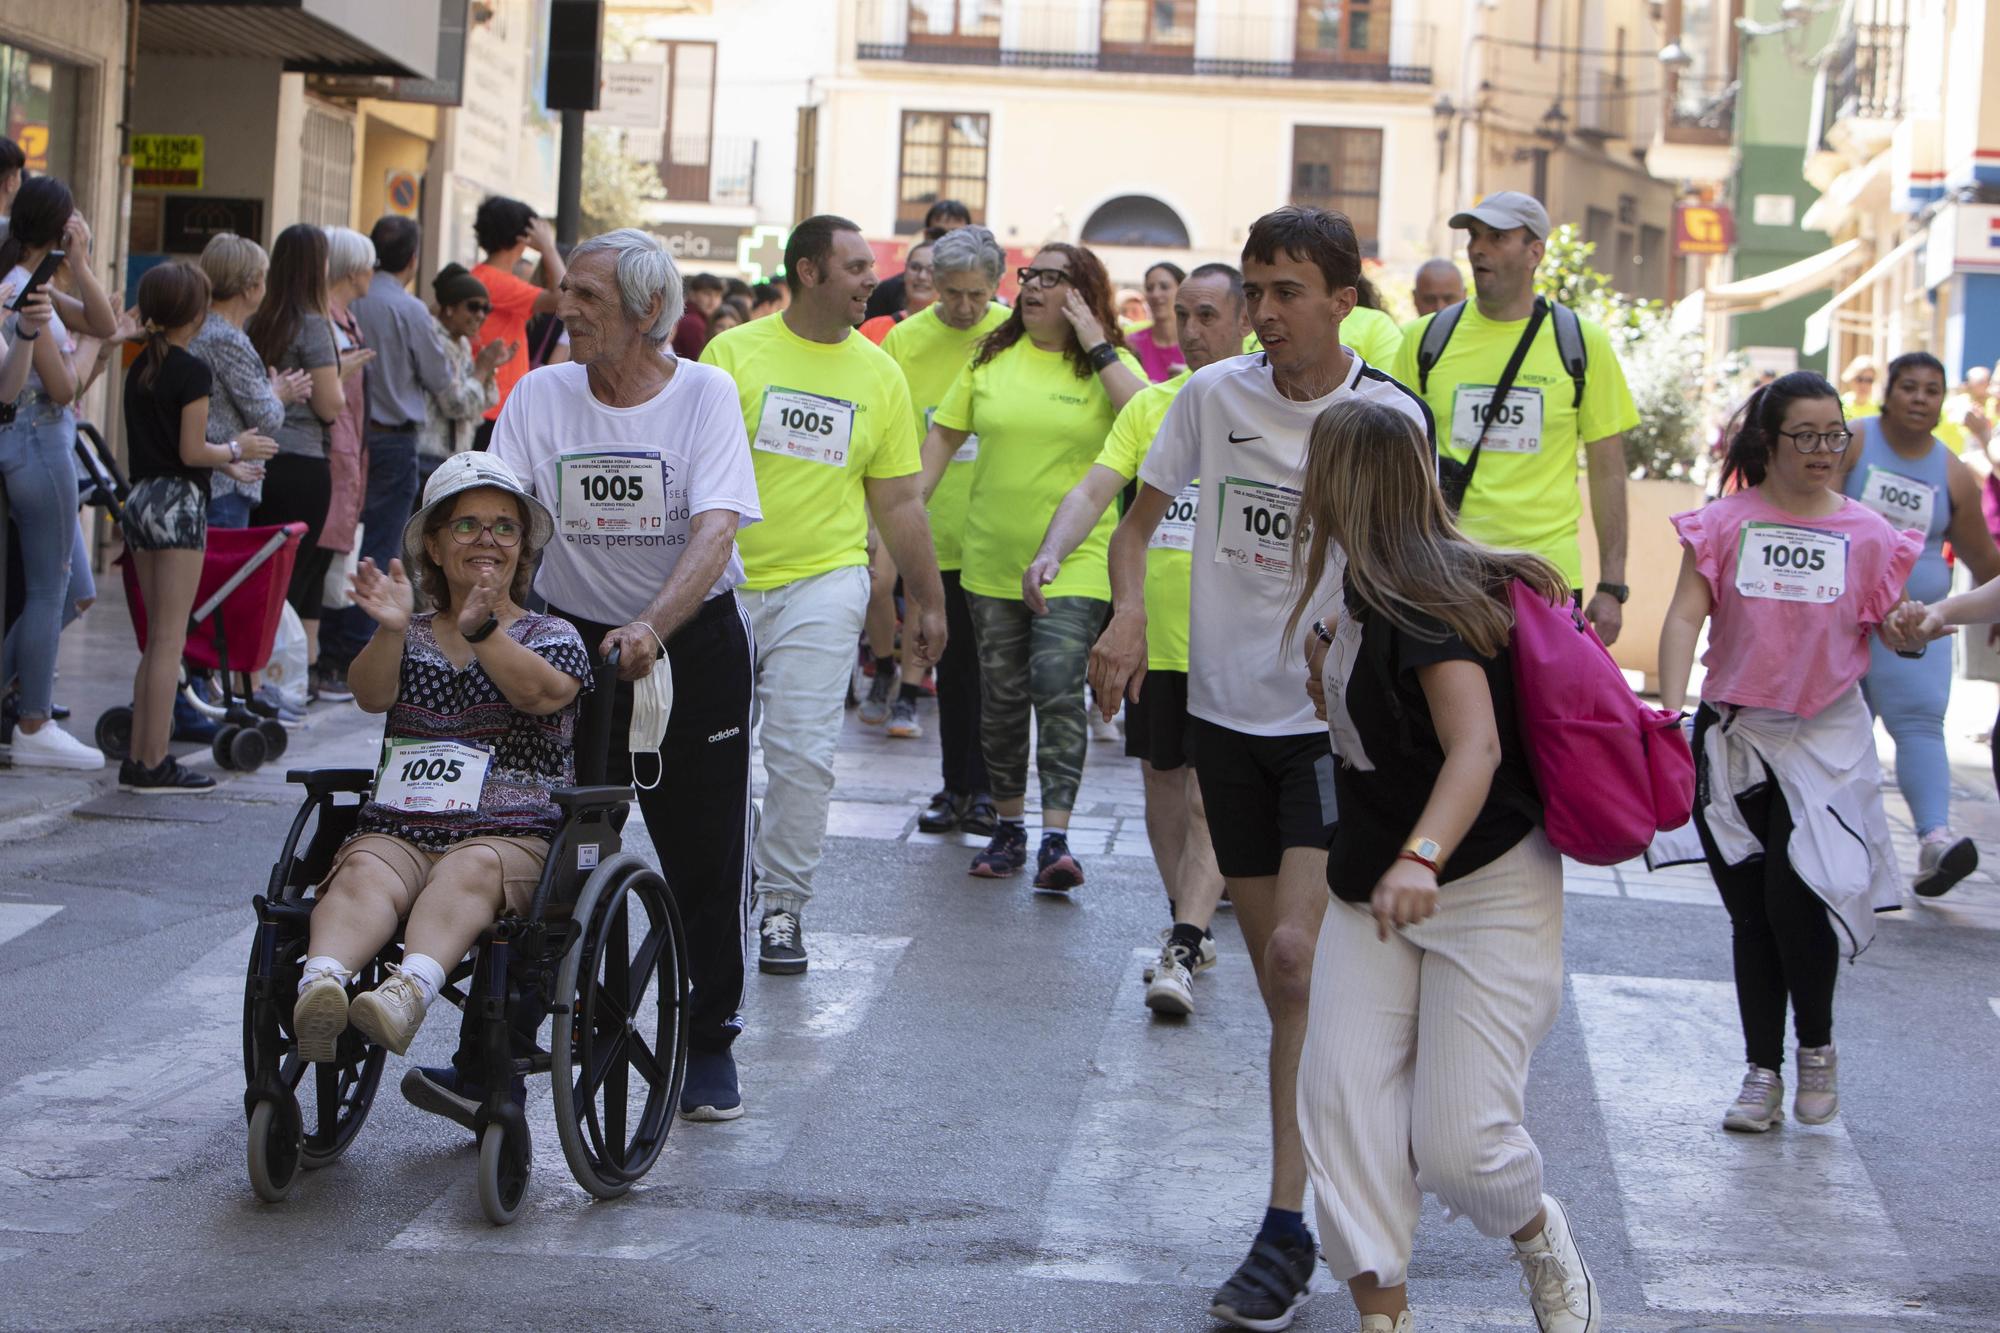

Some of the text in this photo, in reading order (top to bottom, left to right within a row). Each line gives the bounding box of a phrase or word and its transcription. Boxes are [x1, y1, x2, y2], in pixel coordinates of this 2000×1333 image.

[132, 139, 197, 154] SE VENDE
[146, 154, 181, 167] PISO
[781, 407, 834, 436] 1005
[580, 475, 644, 501] 1005
[1880, 485, 1922, 511] 1005
[1242, 505, 1309, 543] 100
[579, 534, 600, 545] las
[606, 534, 686, 549] personas
[1762, 544, 1826, 571] 1005
[708, 726, 740, 743] adidas
[400, 758, 465, 783] 1005
